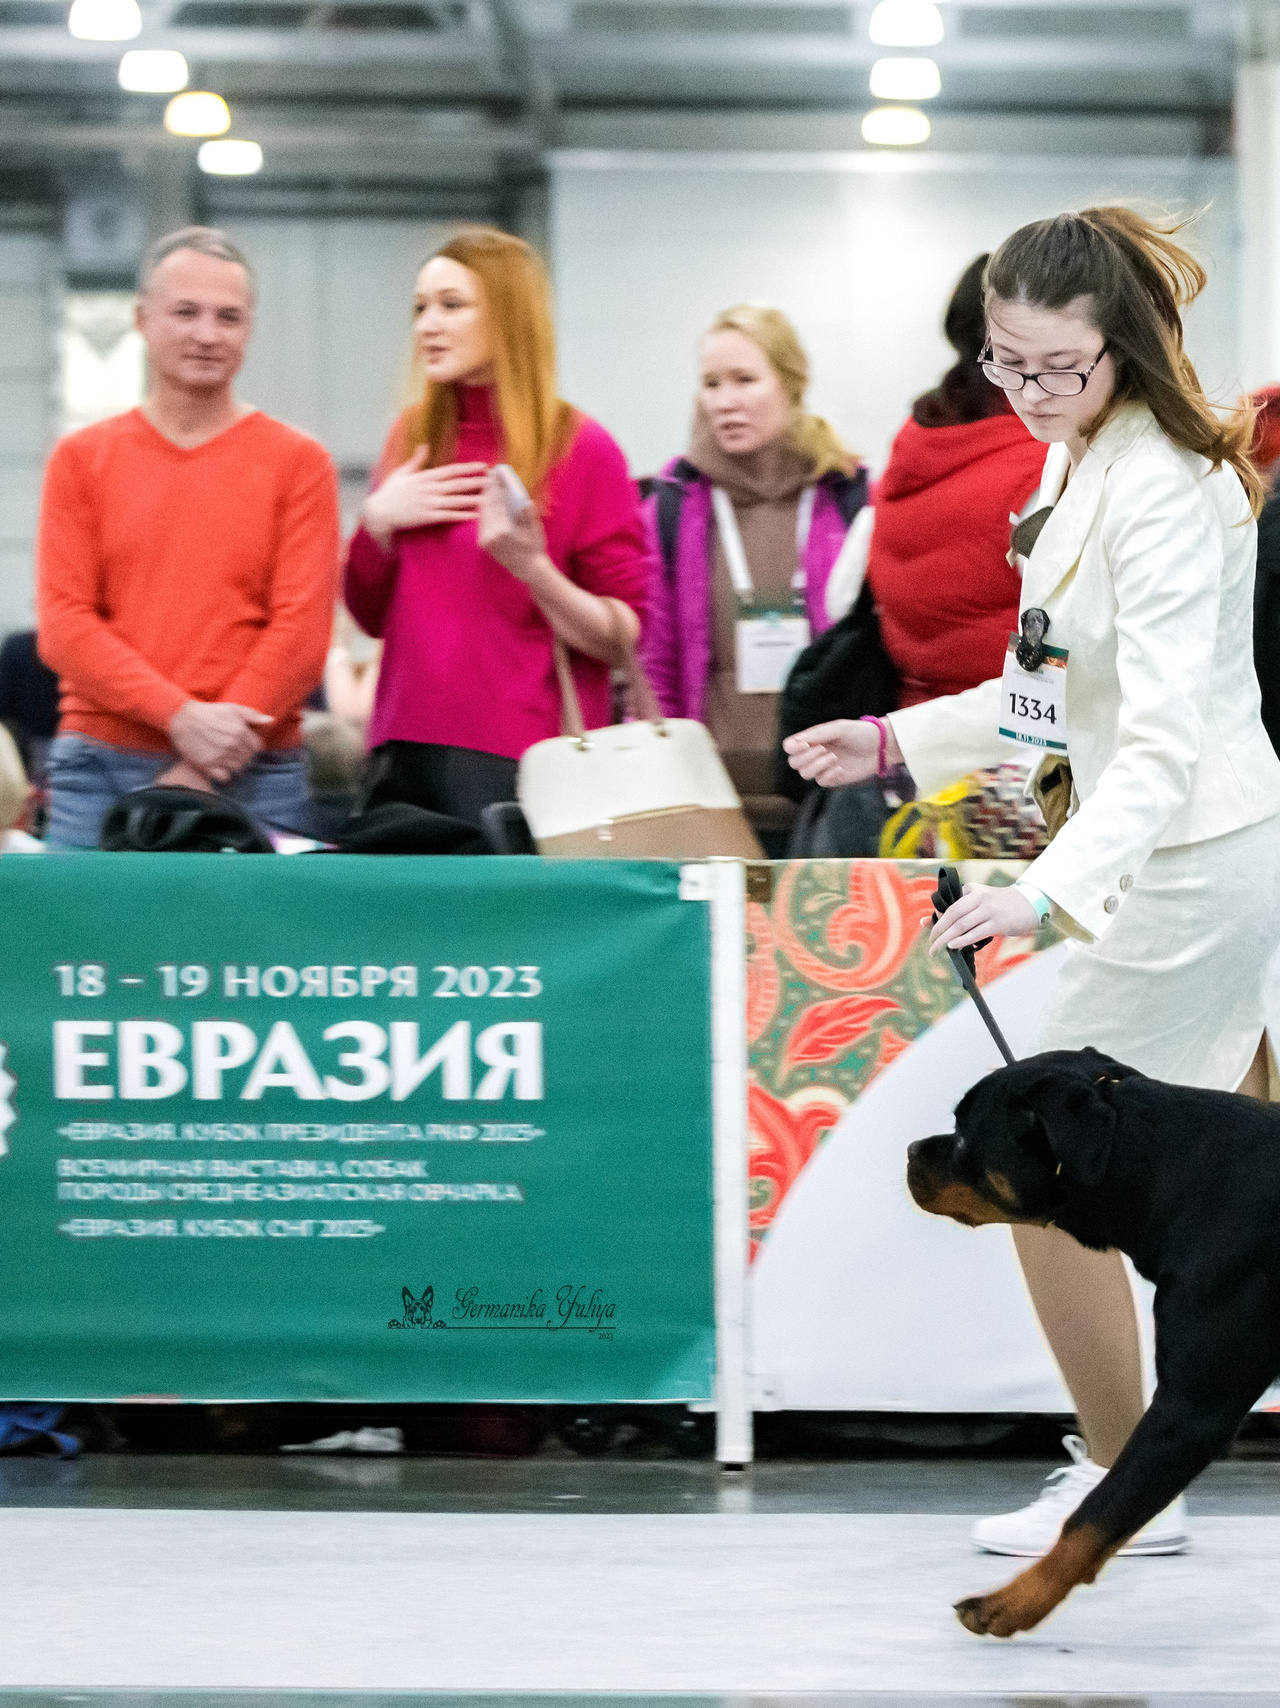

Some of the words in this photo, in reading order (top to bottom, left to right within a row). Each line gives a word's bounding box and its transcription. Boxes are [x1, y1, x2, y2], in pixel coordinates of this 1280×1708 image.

[1009, 693, 1057, 724] 1334
[53, 965, 106, 998] 18
[156, 965, 209, 998] 19
[223, 965, 419, 998] НОЯБРЯ
[432, 965, 543, 998] 2023
[52, 1019, 545, 1101] ЕВРАЗИЯ
